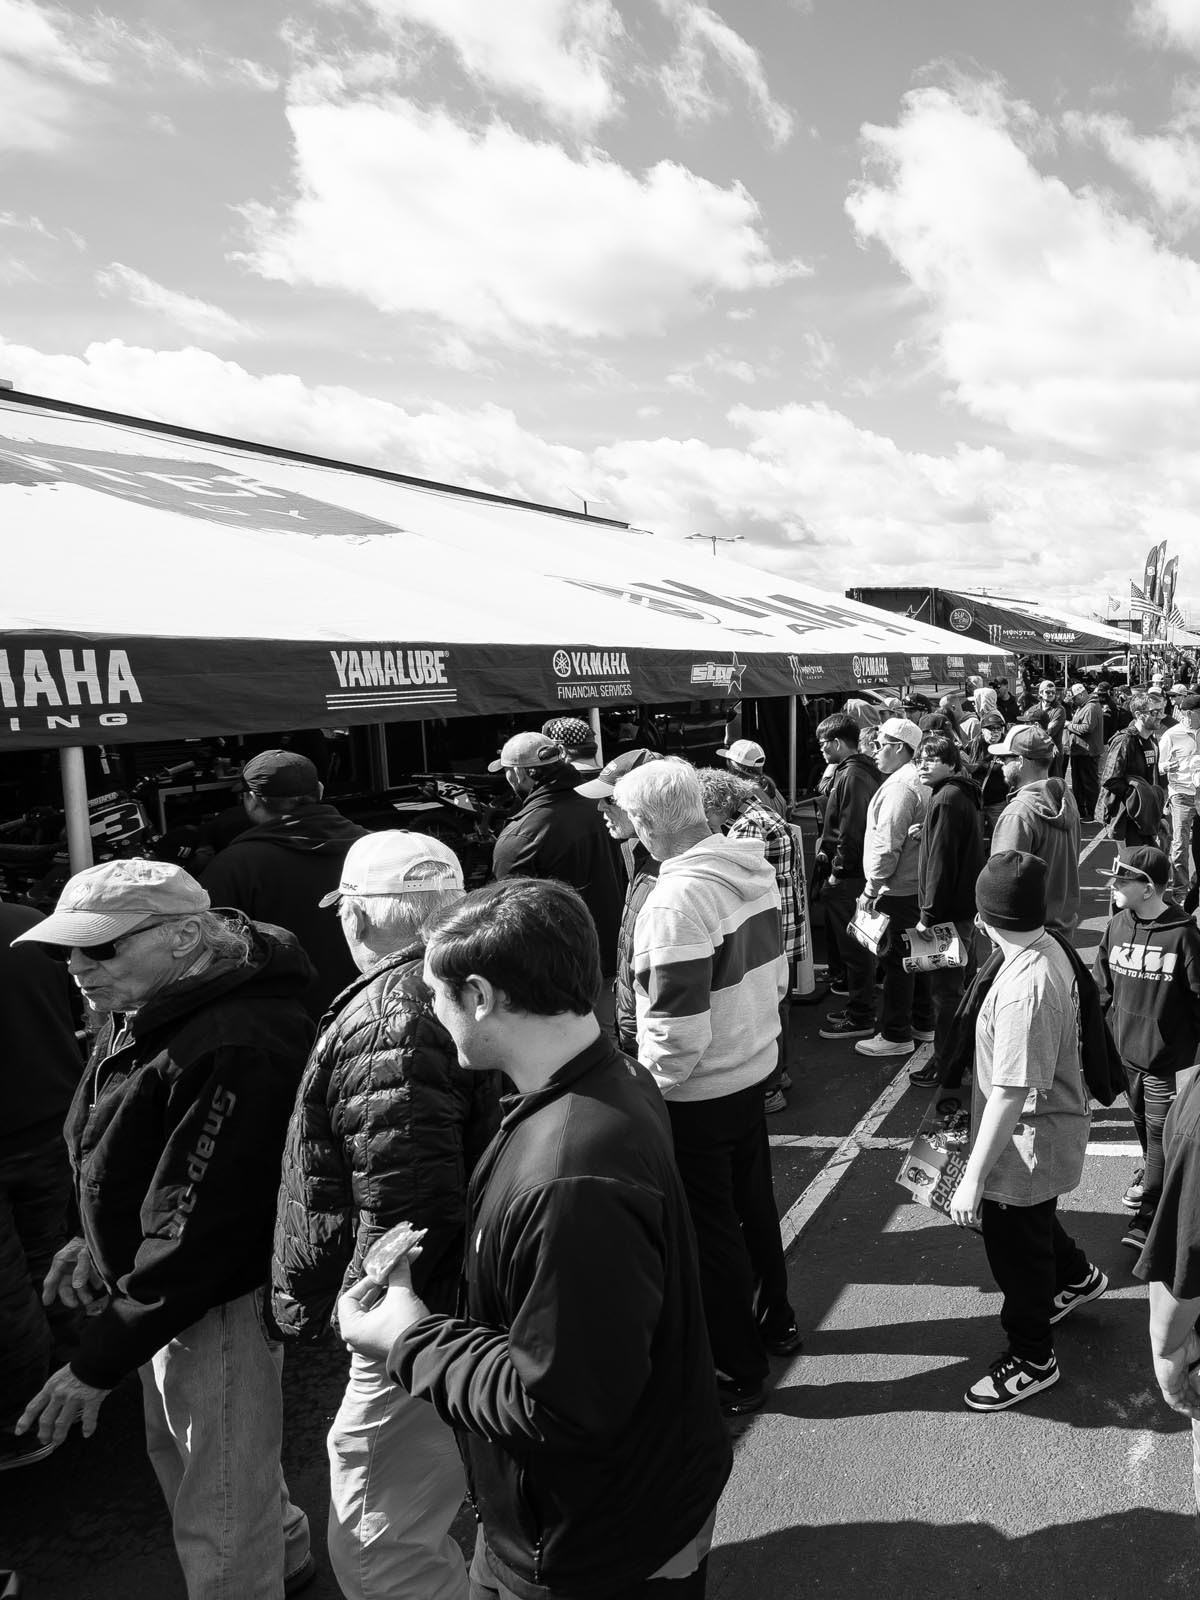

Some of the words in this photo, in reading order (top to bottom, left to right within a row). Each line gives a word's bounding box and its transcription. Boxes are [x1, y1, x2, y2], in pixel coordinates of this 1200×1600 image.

[330, 650, 449, 687] YAMALUBE
[571, 652, 630, 675] YAMAHA
[860, 657, 889, 676] YAMAHA
[558, 685, 599, 699] FINANCIAL
[600, 684, 633, 698] SERVICES
[1109, 943, 1178, 974] KTM
[1128, 969, 1138, 978] TO
[932, 1155, 963, 1206] CHASE
